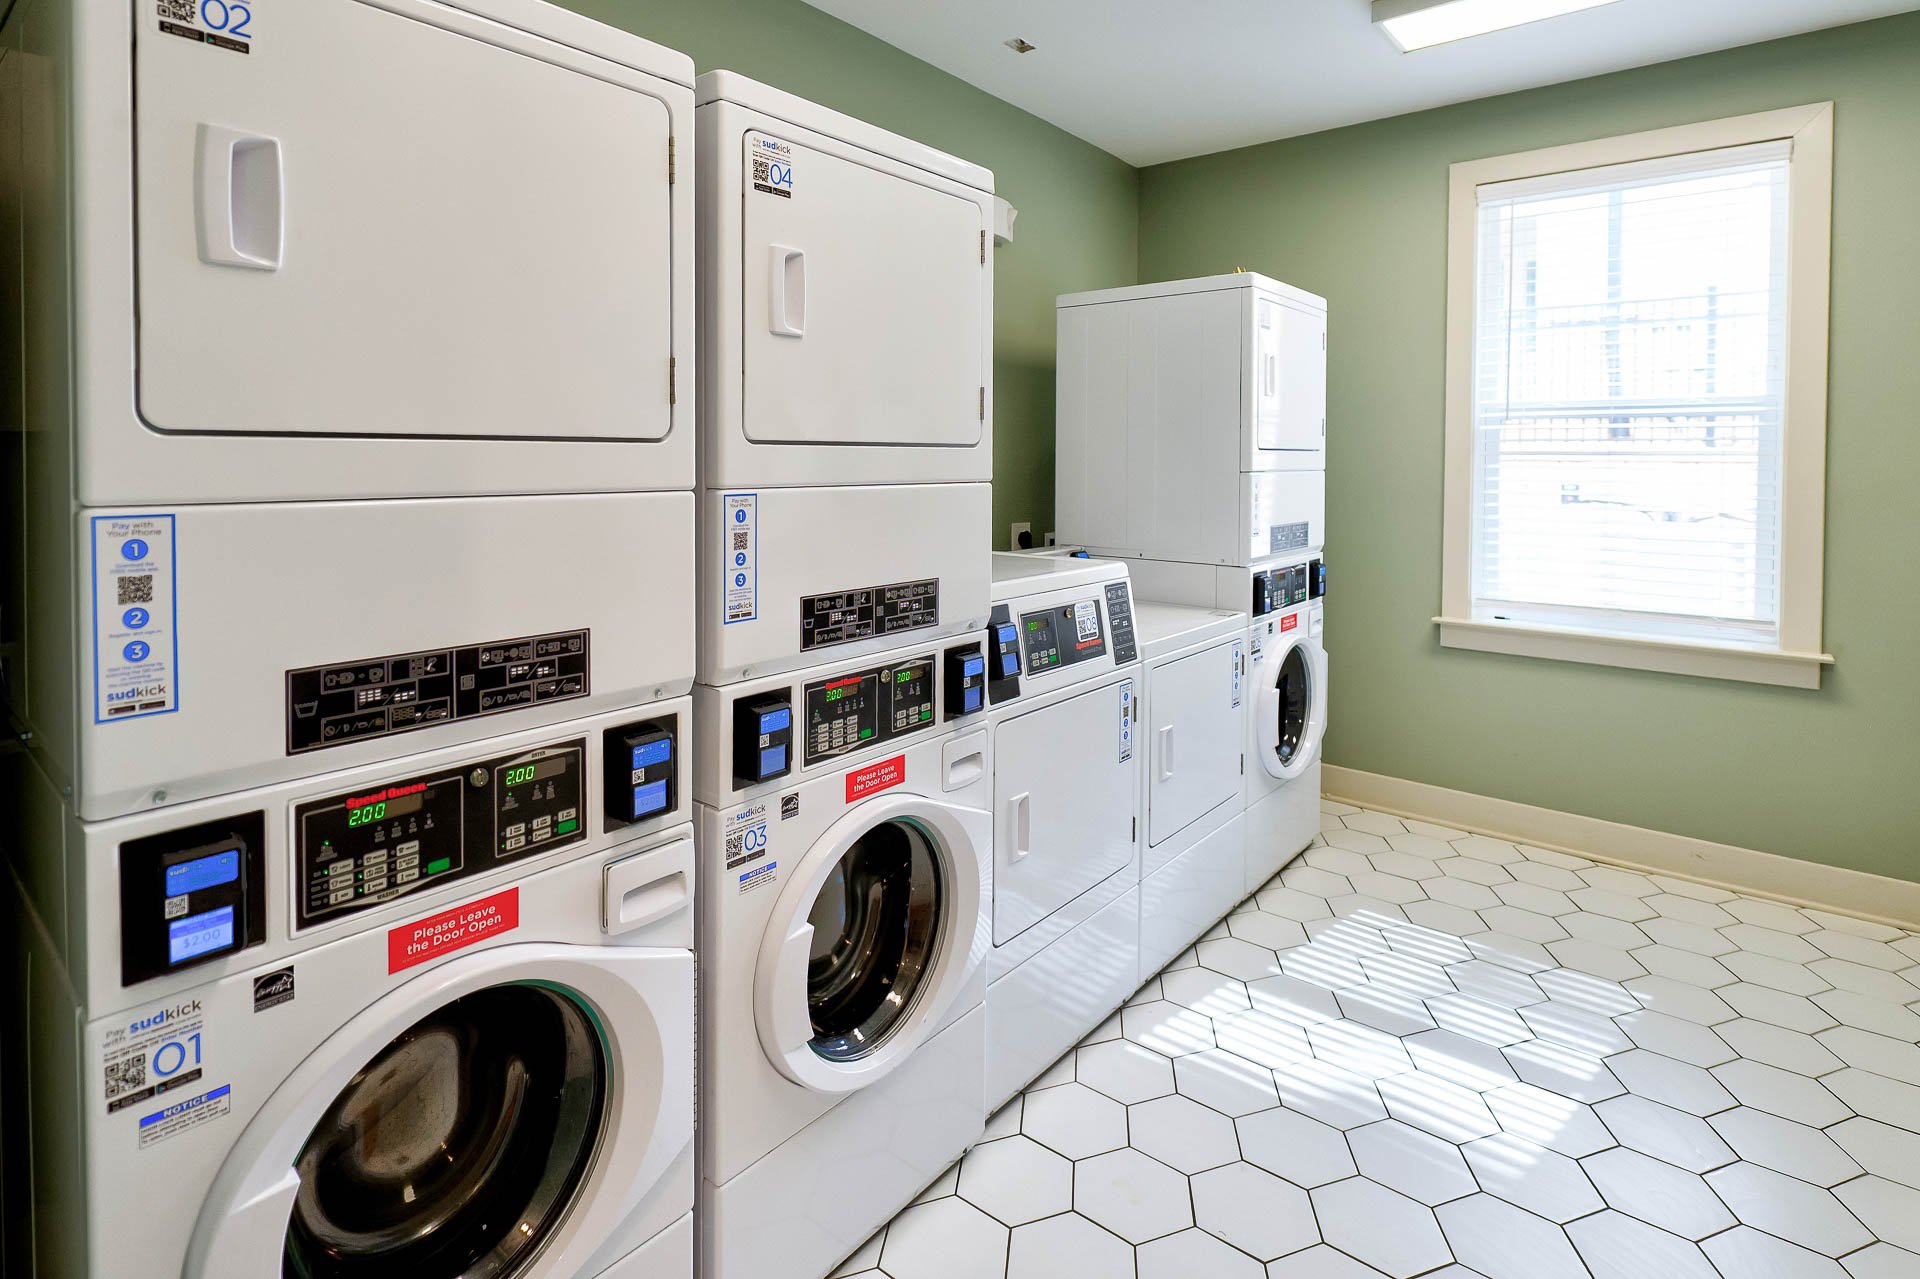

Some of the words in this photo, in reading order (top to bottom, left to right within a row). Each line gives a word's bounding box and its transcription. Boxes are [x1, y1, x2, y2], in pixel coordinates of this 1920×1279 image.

[201, 0, 252, 39] 02
[762, 140, 791, 155] sudkick
[770, 163, 793, 189] 04
[729, 601, 753, 611] sudkick
[130, 611, 143, 626] 2
[131, 643, 144, 660] 3
[107, 684, 167, 702] sudkick
[505, 766, 535, 786] 2.00
[853, 784, 865, 793] the
[865, 778, 881, 788] Door
[881, 772, 898, 783] Open
[856, 771, 877, 784] Please
[877, 765, 895, 776] Leave
[345, 789, 387, 810] Speed
[387, 782, 428, 799] Queen
[348, 802, 386, 826] 2.00
[736, 804, 766, 821] sudkick
[744, 824, 767, 851] 03
[376, 889, 400, 902] WASHER
[413, 919, 457, 942] Please
[460, 905, 496, 925] Leave
[406, 942, 429, 956] the
[433, 928, 465, 947] Door
[468, 914, 502, 932] Open
[129, 999, 203, 1035] sudkick
[103, 1035, 127, 1049] with
[105, 1026, 127, 1040] Pay
[152, 1032, 201, 1078] 01
[163, 1093, 209, 1119] NOTICE
